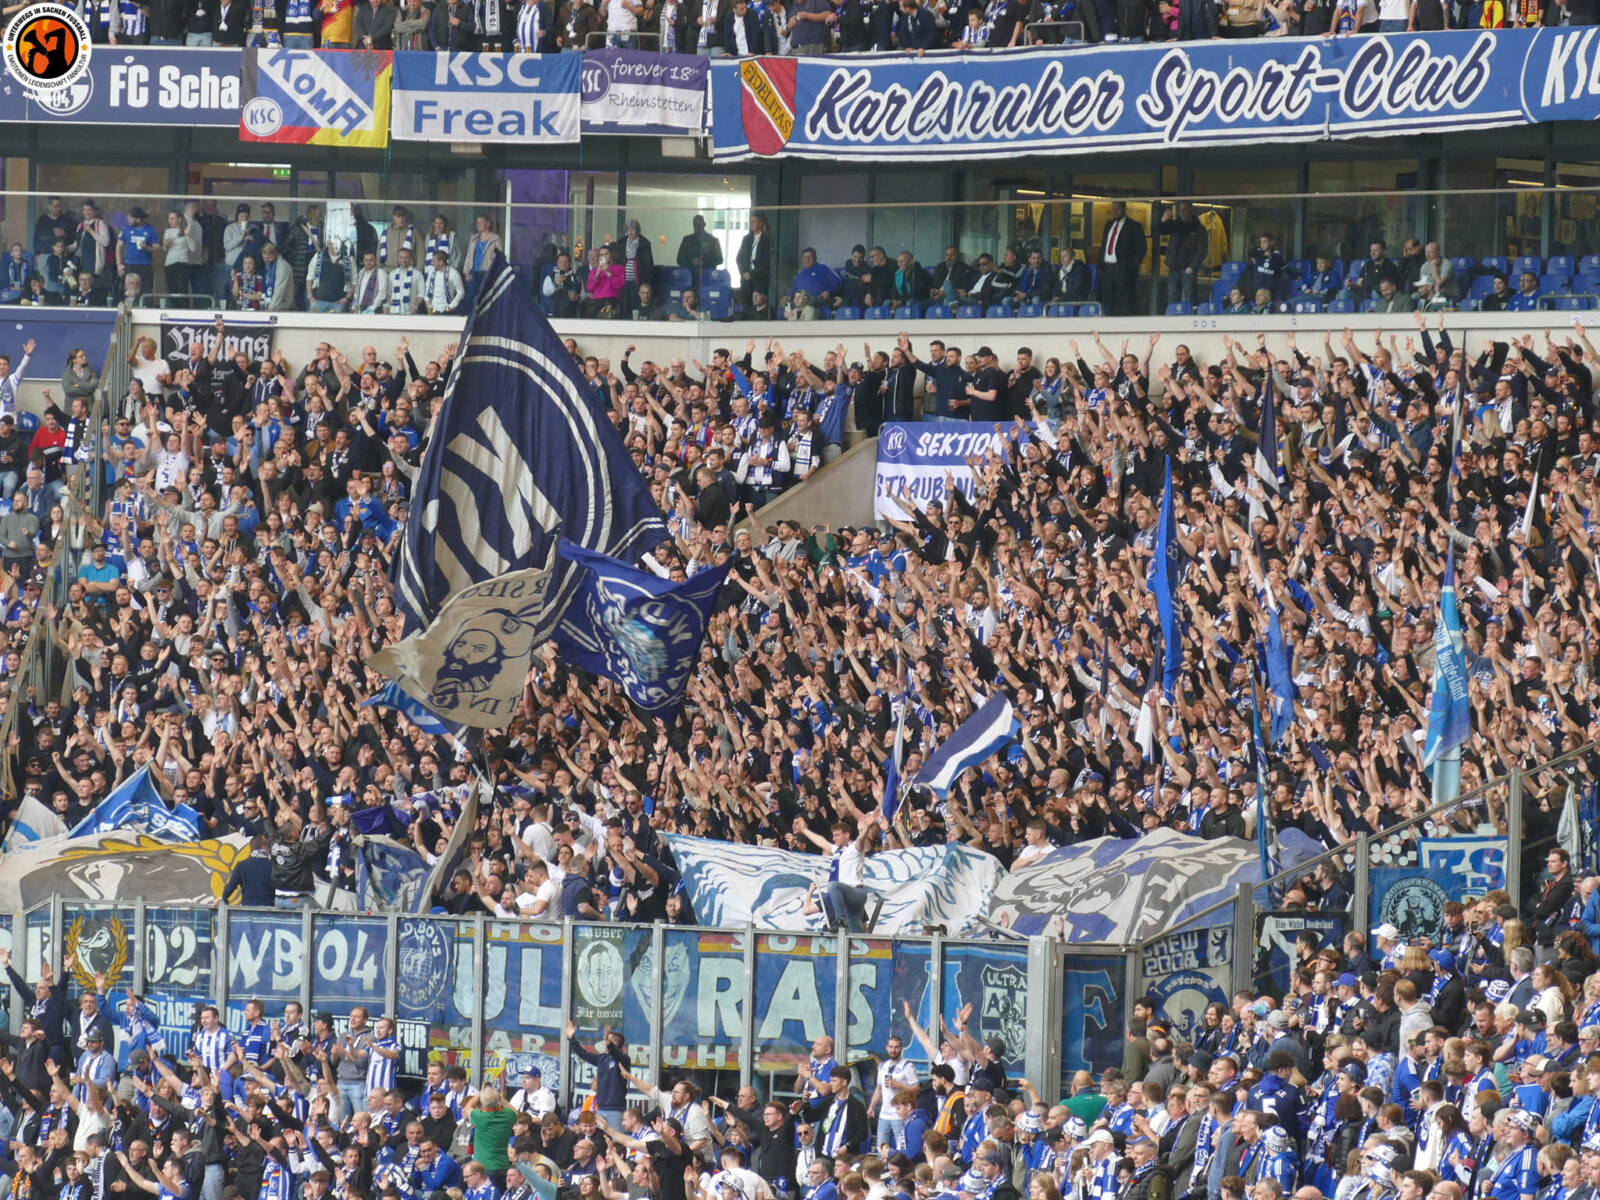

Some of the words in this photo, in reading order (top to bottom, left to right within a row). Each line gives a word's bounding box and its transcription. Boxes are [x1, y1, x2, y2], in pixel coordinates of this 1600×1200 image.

[110, 64, 149, 108] FC
[159, 65, 241, 110] Scha
[434, 51, 543, 87] KSC
[611, 57, 668, 81] forever
[805, 60, 1125, 143] Karlsruher
[1136, 30, 1498, 144] Sport-Club
[268, 48, 368, 138] KOMA
[608, 91, 695, 113] Rheinstetten
[743, 63, 792, 134] FIDELITAS
[249, 107, 276, 126] KSC
[413, 99, 561, 137] Freak
[916, 431, 1009, 457] SEKTION
[1438, 649, 1468, 701] Borderland
[146, 923, 199, 986] 02
[214, 928, 303, 992] WB
[986, 971, 1028, 990] ULTRA
[399, 1020, 428, 1050] FÜR
[1262, 1098, 1279, 1118] 5
